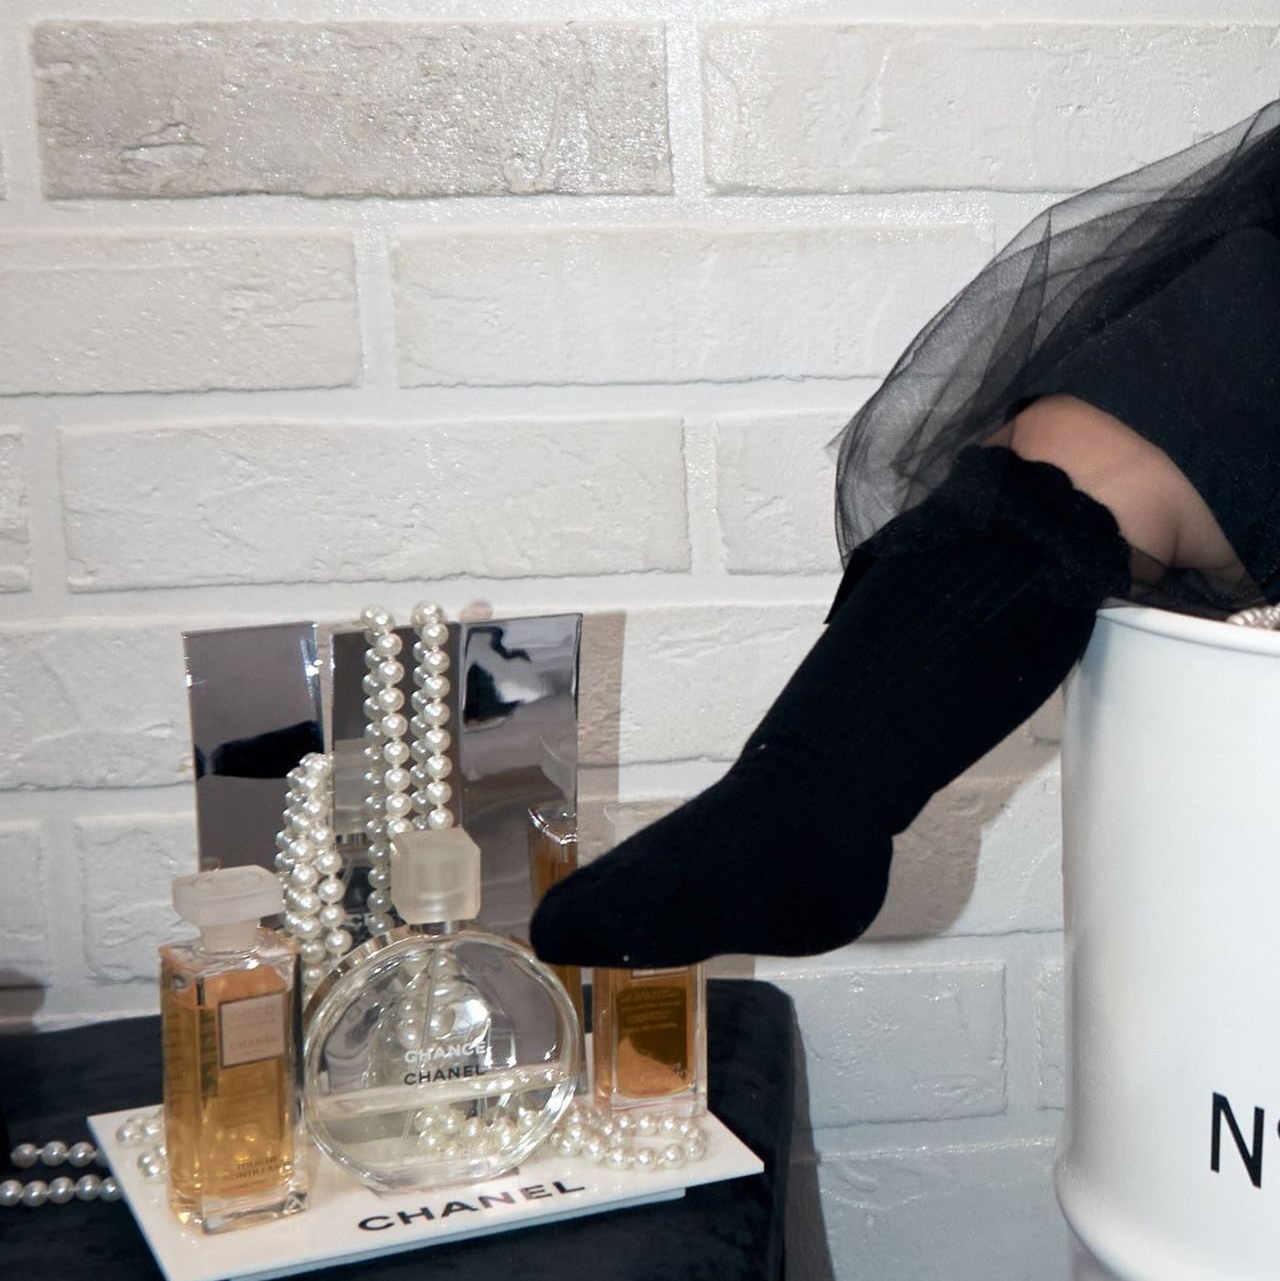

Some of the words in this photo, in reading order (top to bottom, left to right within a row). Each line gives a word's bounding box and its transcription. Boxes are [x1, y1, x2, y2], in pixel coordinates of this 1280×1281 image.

[404, 1041, 487, 1063] CHANCE
[404, 1064, 486, 1085] CHANEL
[358, 1180, 586, 1230] CHANEL
